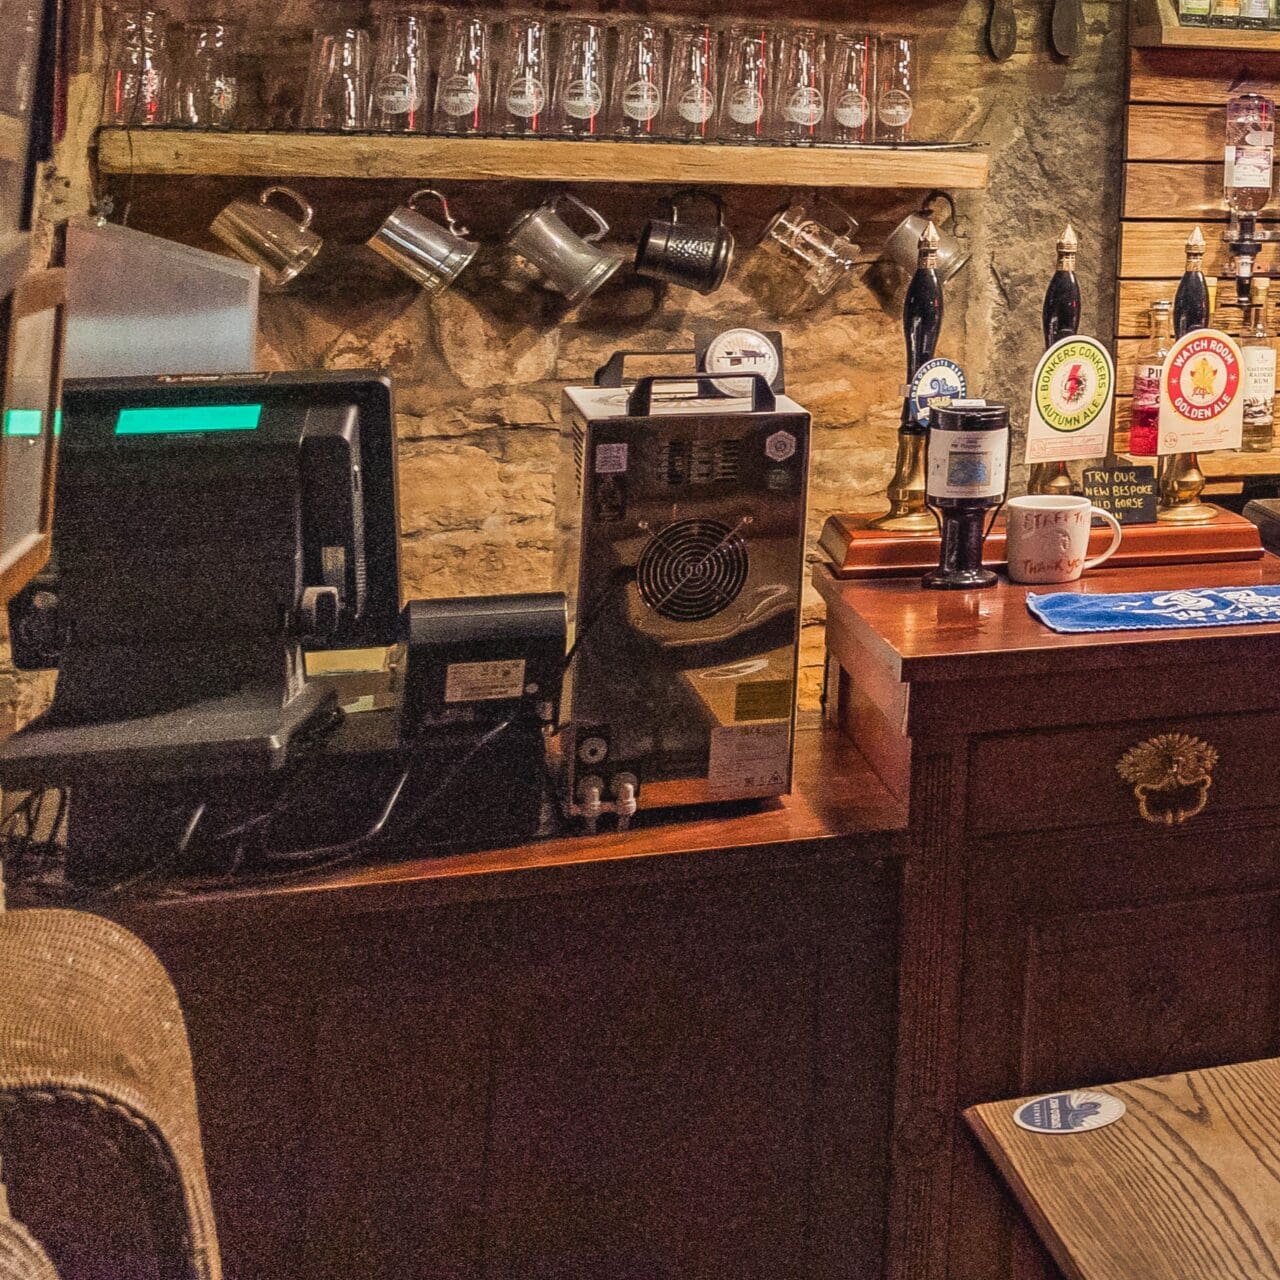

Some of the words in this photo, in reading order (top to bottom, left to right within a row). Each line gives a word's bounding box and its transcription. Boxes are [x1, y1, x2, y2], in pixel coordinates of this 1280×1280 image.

[1173, 339, 1208, 367] WATCH
[1209, 339, 1235, 365] ROOM
[1040, 346, 1077, 392] BONKERS
[1078, 346, 1107, 389] CONKERS
[1042, 403, 1081, 426] AUTUMN
[1083, 399, 1101, 423] ALE
[1174, 397, 1212, 419] GOLDEN
[1213, 394, 1232, 416] ALE
[1085, 471, 1109, 484] TRY
[1113, 471, 1138, 483] OUR
[1085, 487, 1110, 497] NEW
[1112, 484, 1153, 497] BESPOKE
[1114, 497, 1144, 509] GORSE
